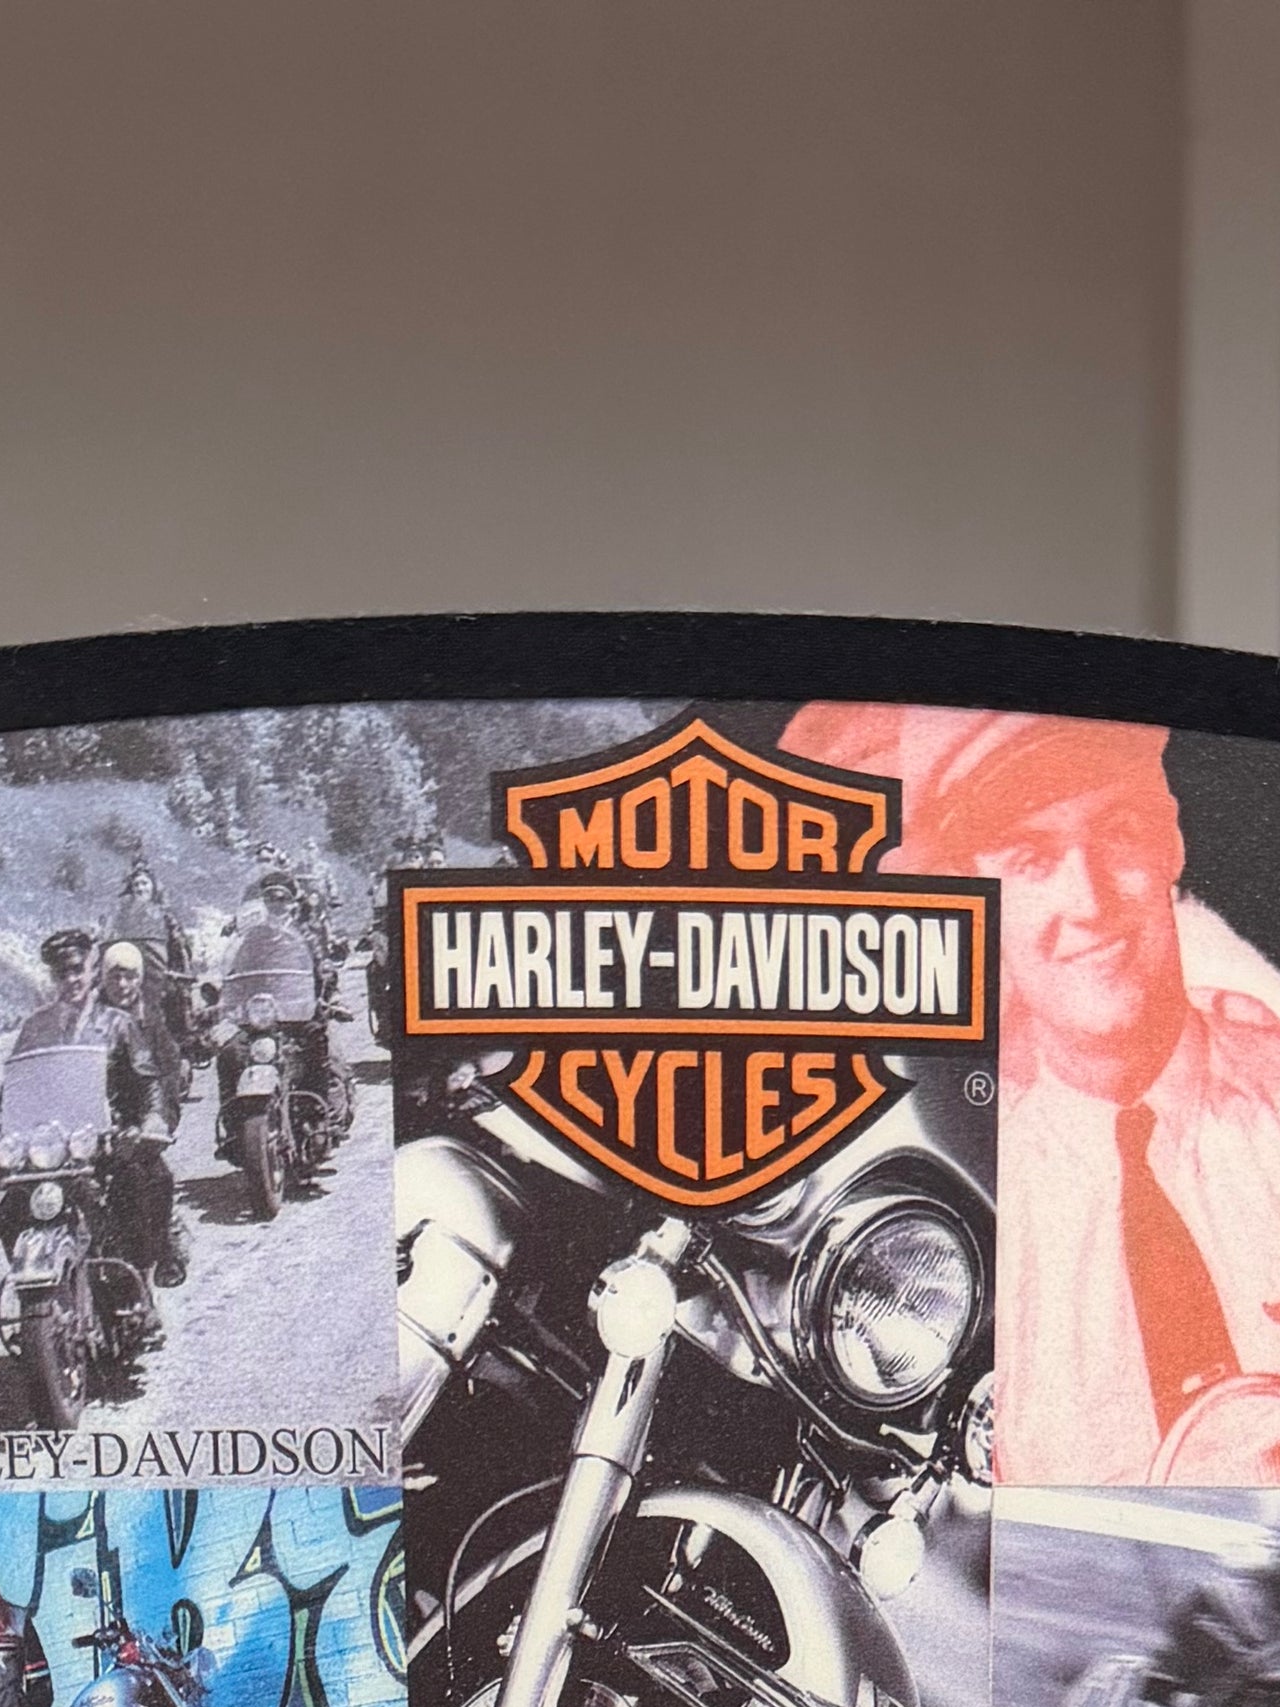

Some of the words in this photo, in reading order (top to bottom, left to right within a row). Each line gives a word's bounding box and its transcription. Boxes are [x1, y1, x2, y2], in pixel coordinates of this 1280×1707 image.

[559, 754, 838, 873] MOTOR
[431, 910, 959, 1016] HARLEY-DAVIDSON
[559, 1050, 836, 1182] CYCLES
